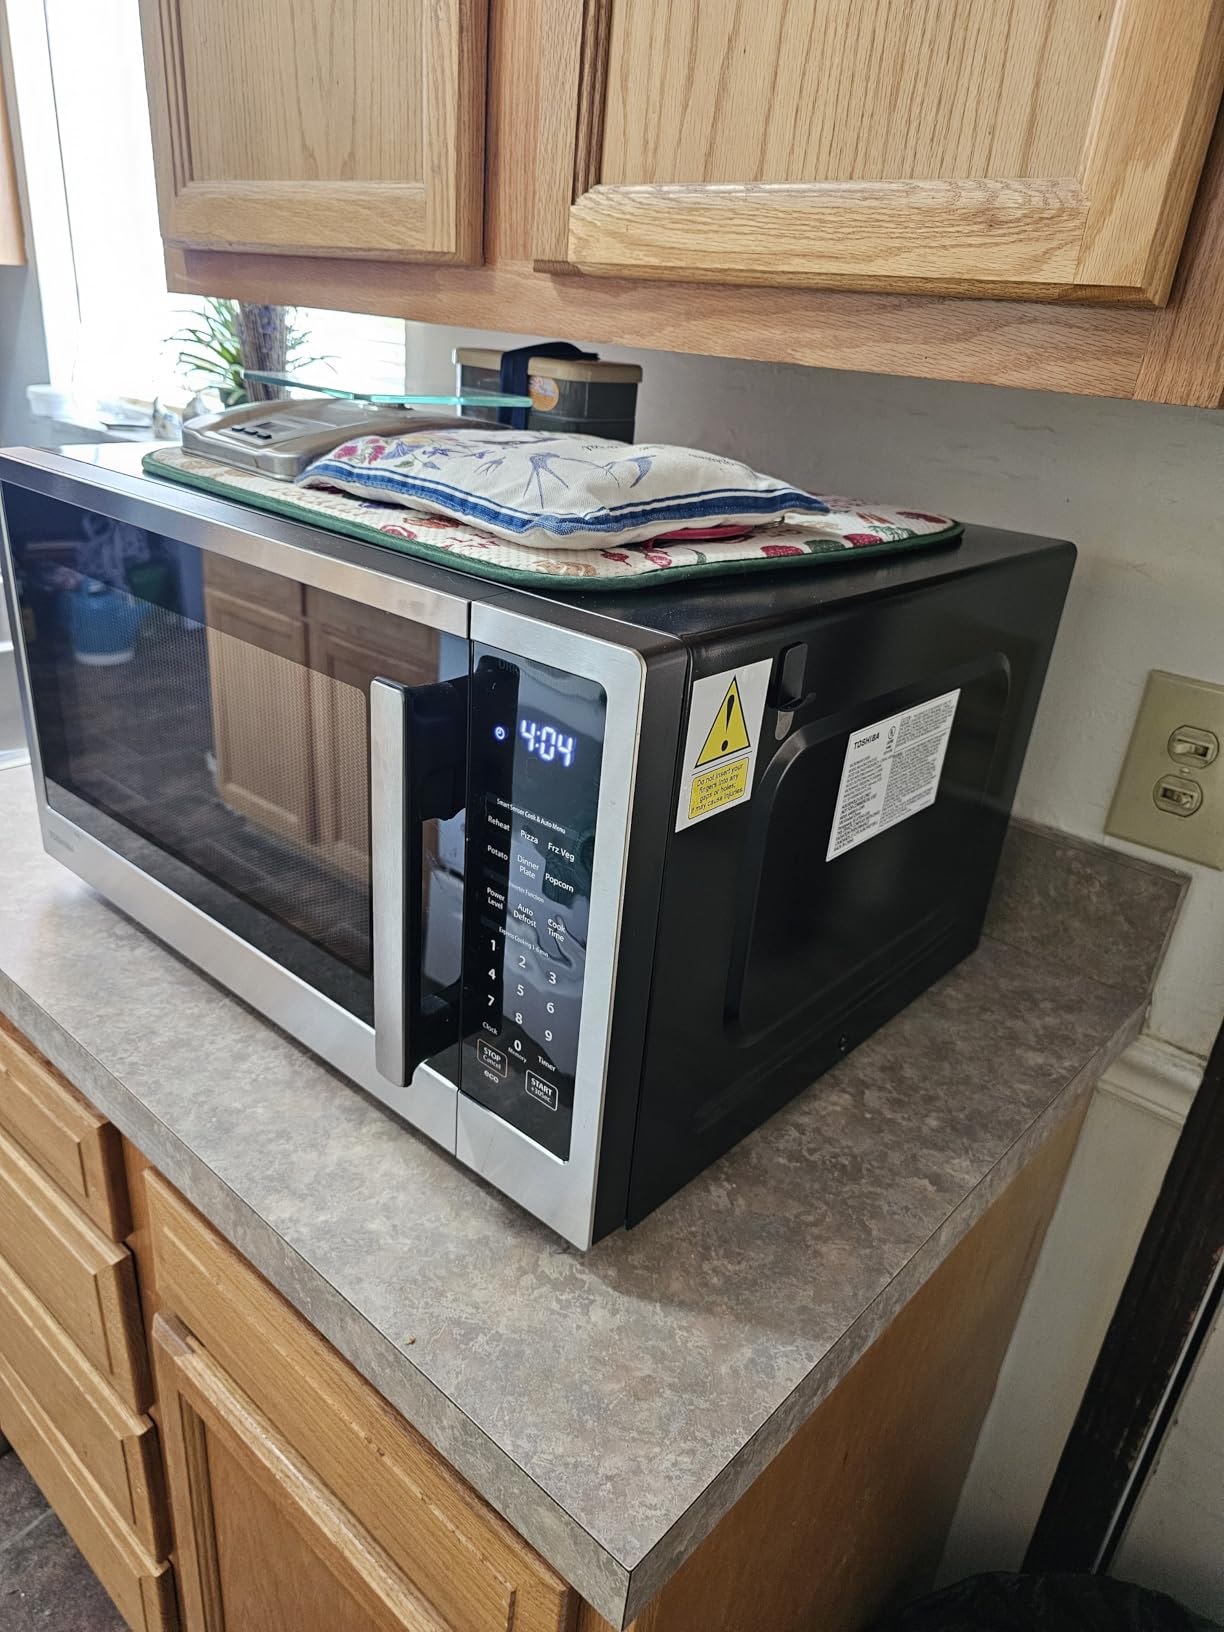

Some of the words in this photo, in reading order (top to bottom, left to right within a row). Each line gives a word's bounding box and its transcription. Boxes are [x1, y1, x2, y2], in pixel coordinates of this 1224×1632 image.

[520, 719, 574, 767] 4:04
[853, 732, 880, 750] TOSHIBA
[696, 779, 705, 787] Do
[706, 775, 715, 783] not
[715, 768, 731, 778] insert
[731, 763, 744, 774] your
[699, 783, 717, 794] fingers
[718, 777, 729, 786] into
[729, 774, 739, 783] any
[695, 803, 707, 812] may
[707, 796, 723, 807] cause
[699, 792, 713, 804] gaps
[487, 815, 511, 831] Reheat
[496, 798, 510, 809] Smart
[509, 803, 525, 815] Sensor
[524, 811, 537, 820] Cook
[541, 818, 552, 828] Auto
[551, 823, 566, 834] Menu
[520, 829, 539, 844] Pizza
[487, 845, 508, 860] Potato
[517, 855, 540, 870] Dinner
[519, 866, 536, 879] Plate
[545, 873, 575, 893] Popcorn
[487, 887, 505, 902] Power
[487, 897, 504, 910] Level
[517, 903, 534, 917] Auto
[513, 910, 537, 928] Defrost
[547, 918, 566, 933] Cook
[547, 927, 565, 943] Time
[490, 939, 496, 951] 1
[519, 955, 526, 968] 2
[488, 968, 496, 980] 4
[548, 971, 557, 985] 3
[516, 983, 525, 996] 5
[487, 994, 495, 1006] 7
[546, 1002, 555, 1014] 6
[515, 1012, 523, 1025] 8
[482, 1021, 499, 1036] Clock
[544, 1030, 553, 1042] 9
[513, 1039, 522, 1052] 0
[483, 1046, 502, 1062] STOP
[507, 1046, 527, 1064] Memory
[482, 1054, 502, 1071] Cancel
[537, 1055, 557, 1073] Timer
[483, 1069, 500, 1084] eco
[530, 1077, 553, 1097] START
